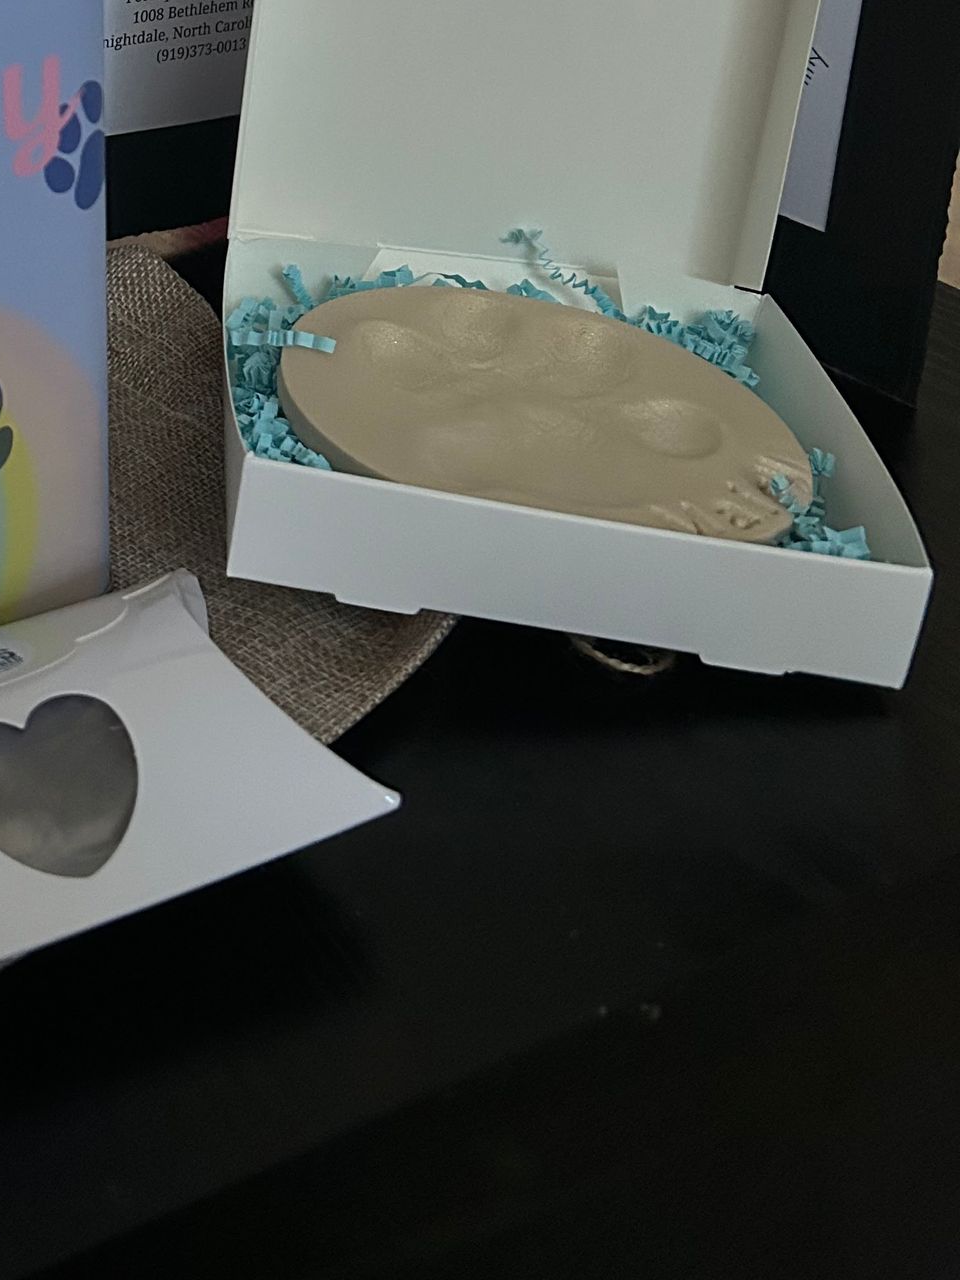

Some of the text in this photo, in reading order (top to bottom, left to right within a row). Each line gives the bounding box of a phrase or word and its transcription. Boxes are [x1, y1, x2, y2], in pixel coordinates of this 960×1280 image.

[133, 7, 164, 24] 1008
[168, 0, 238, 19] Bethlehem
[103, 29, 169, 51] nightdale,
[172, 23, 212, 40] North
[156, 37, 247, 64] (919)373-0013
